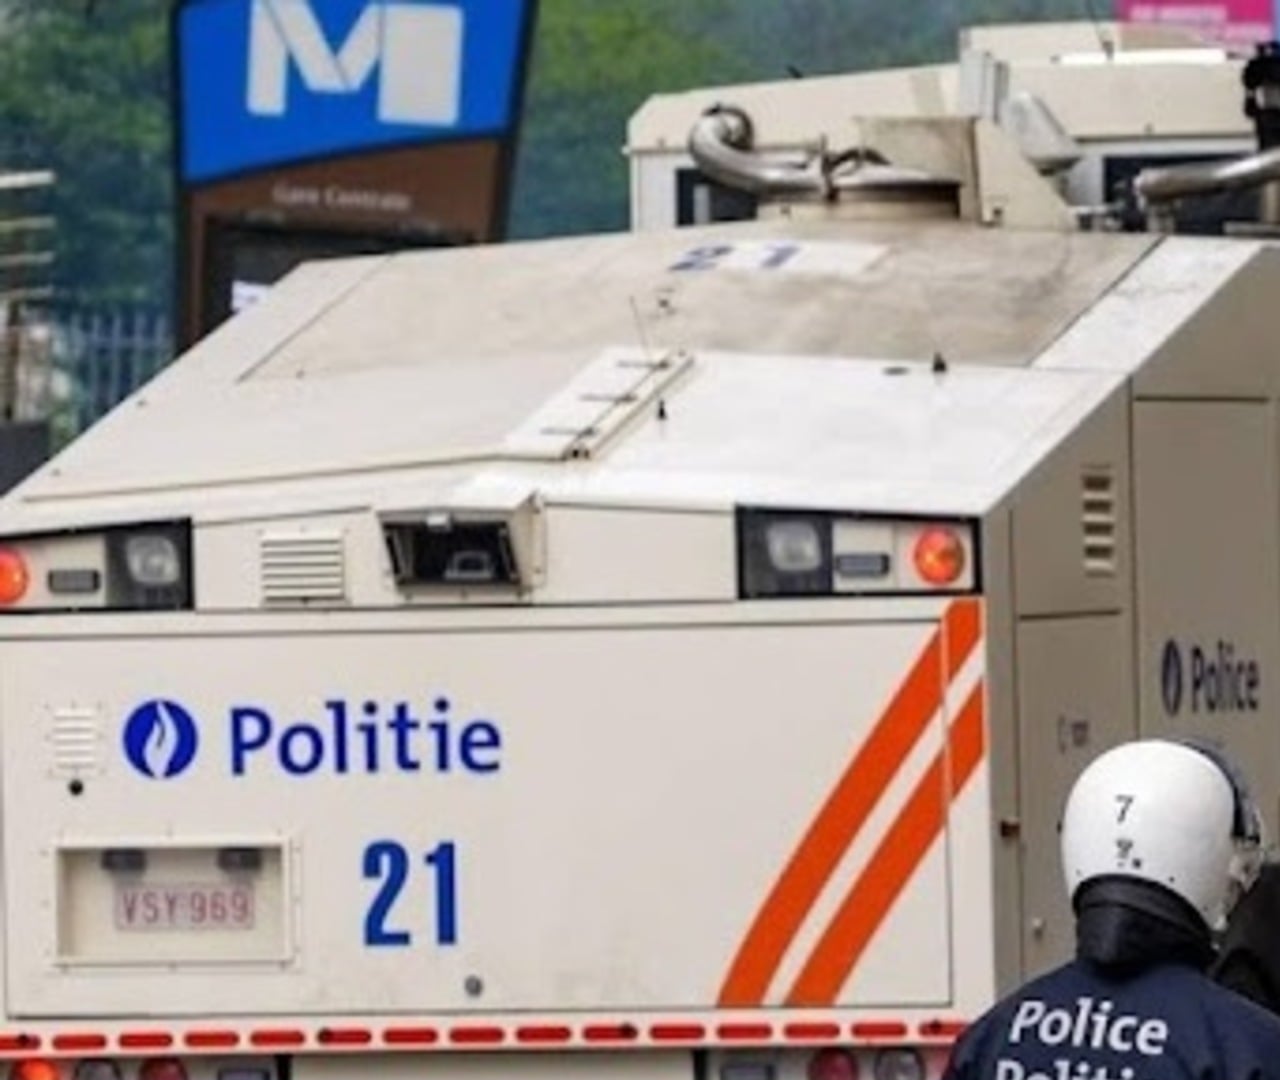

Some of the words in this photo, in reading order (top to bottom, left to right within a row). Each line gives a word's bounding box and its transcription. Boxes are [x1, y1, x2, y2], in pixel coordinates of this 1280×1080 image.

[247, 0, 463, 126] M
[1191, 639, 1260, 714] Police
[229, 697, 502, 777] Politie
[1115, 793, 1135, 824] 7
[361, 839, 457, 946] 21
[1008, 997, 1169, 1055] Police
